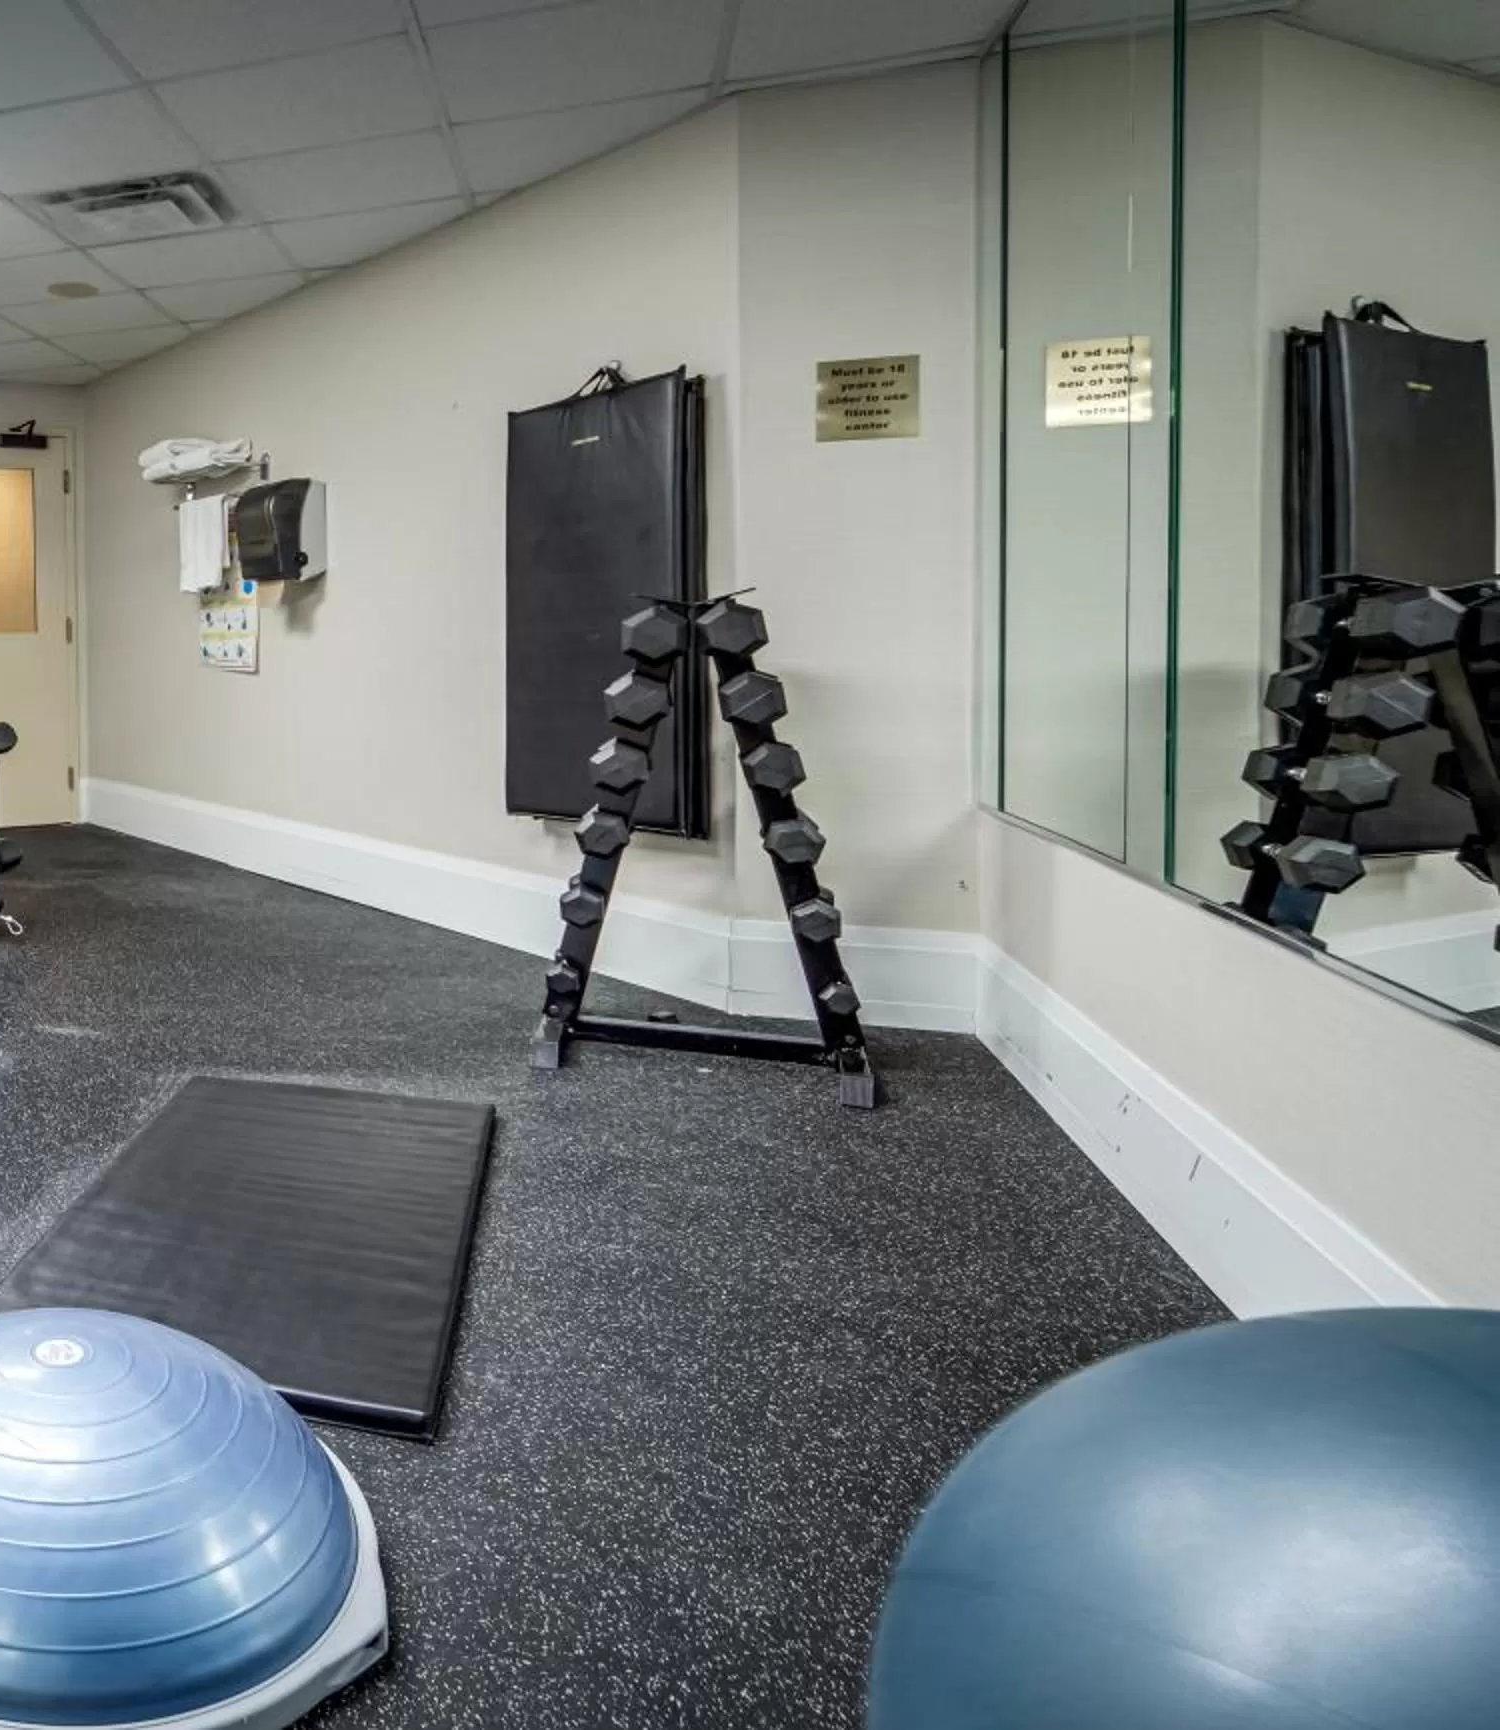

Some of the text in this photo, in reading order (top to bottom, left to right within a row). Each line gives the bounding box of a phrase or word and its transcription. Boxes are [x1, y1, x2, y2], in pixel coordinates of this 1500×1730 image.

[831, 363, 905, 377] Must be 18
[841, 381, 877, 392] years
[827, 393, 909, 404] older to use
[844, 409, 891, 417] fitness
[845, 422, 888, 431] center
